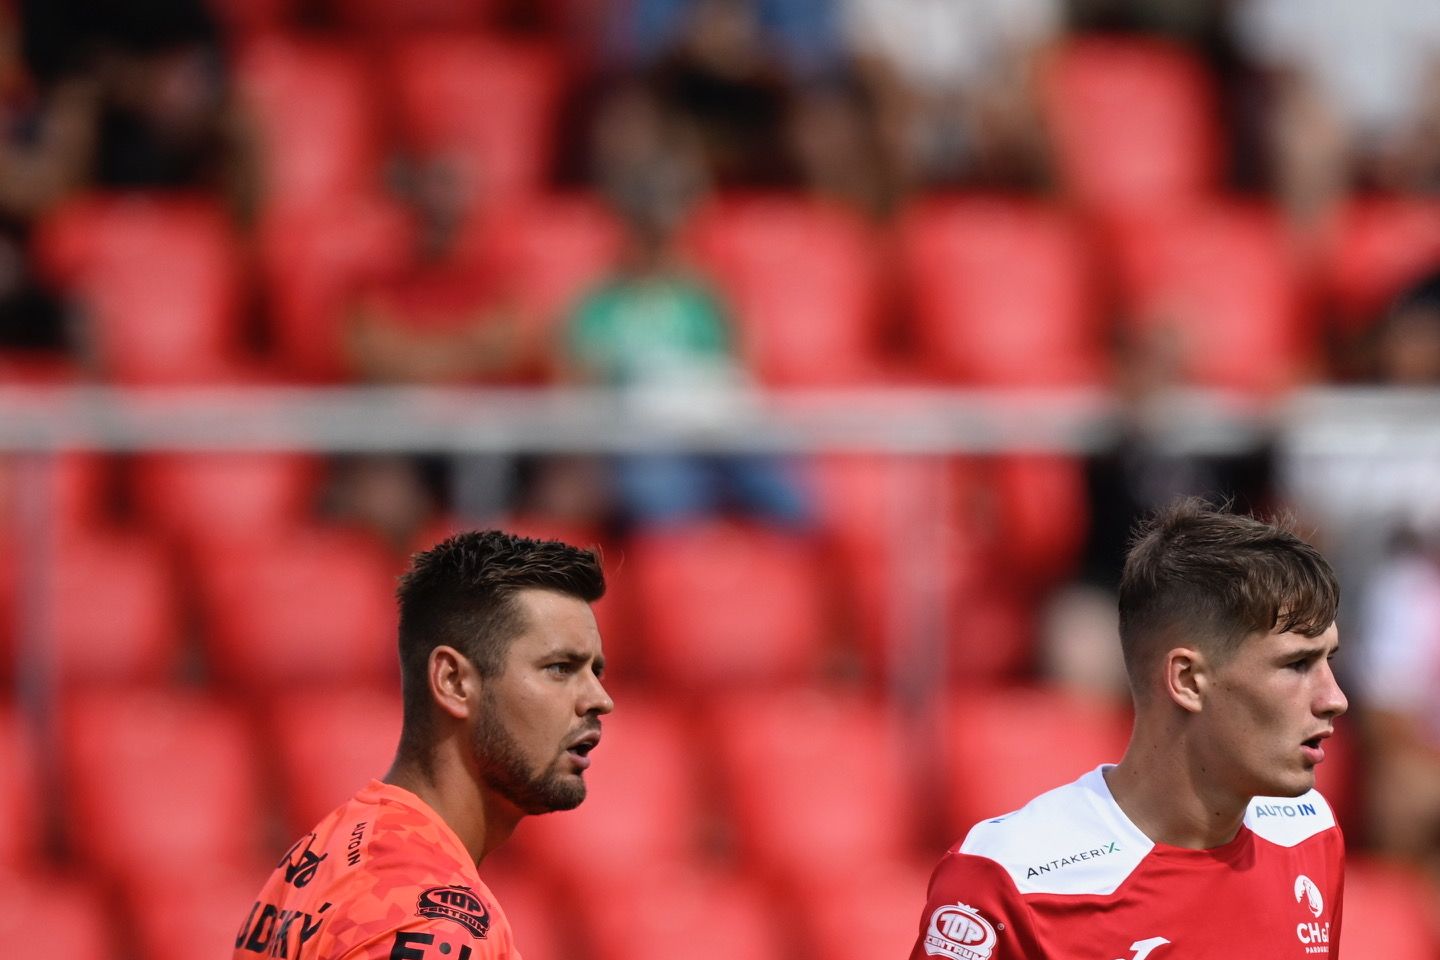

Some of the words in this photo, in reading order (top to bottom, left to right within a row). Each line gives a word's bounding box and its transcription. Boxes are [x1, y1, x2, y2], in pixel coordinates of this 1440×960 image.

[1255, 804, 1296, 818] AUTO
[1298, 803, 1316, 817] IN
[1026, 842, 1120, 879] ANTAKERIX
[434, 890, 482, 913] TOP
[420, 907, 488, 935] CENTRUM
[940, 913, 985, 944] TOP
